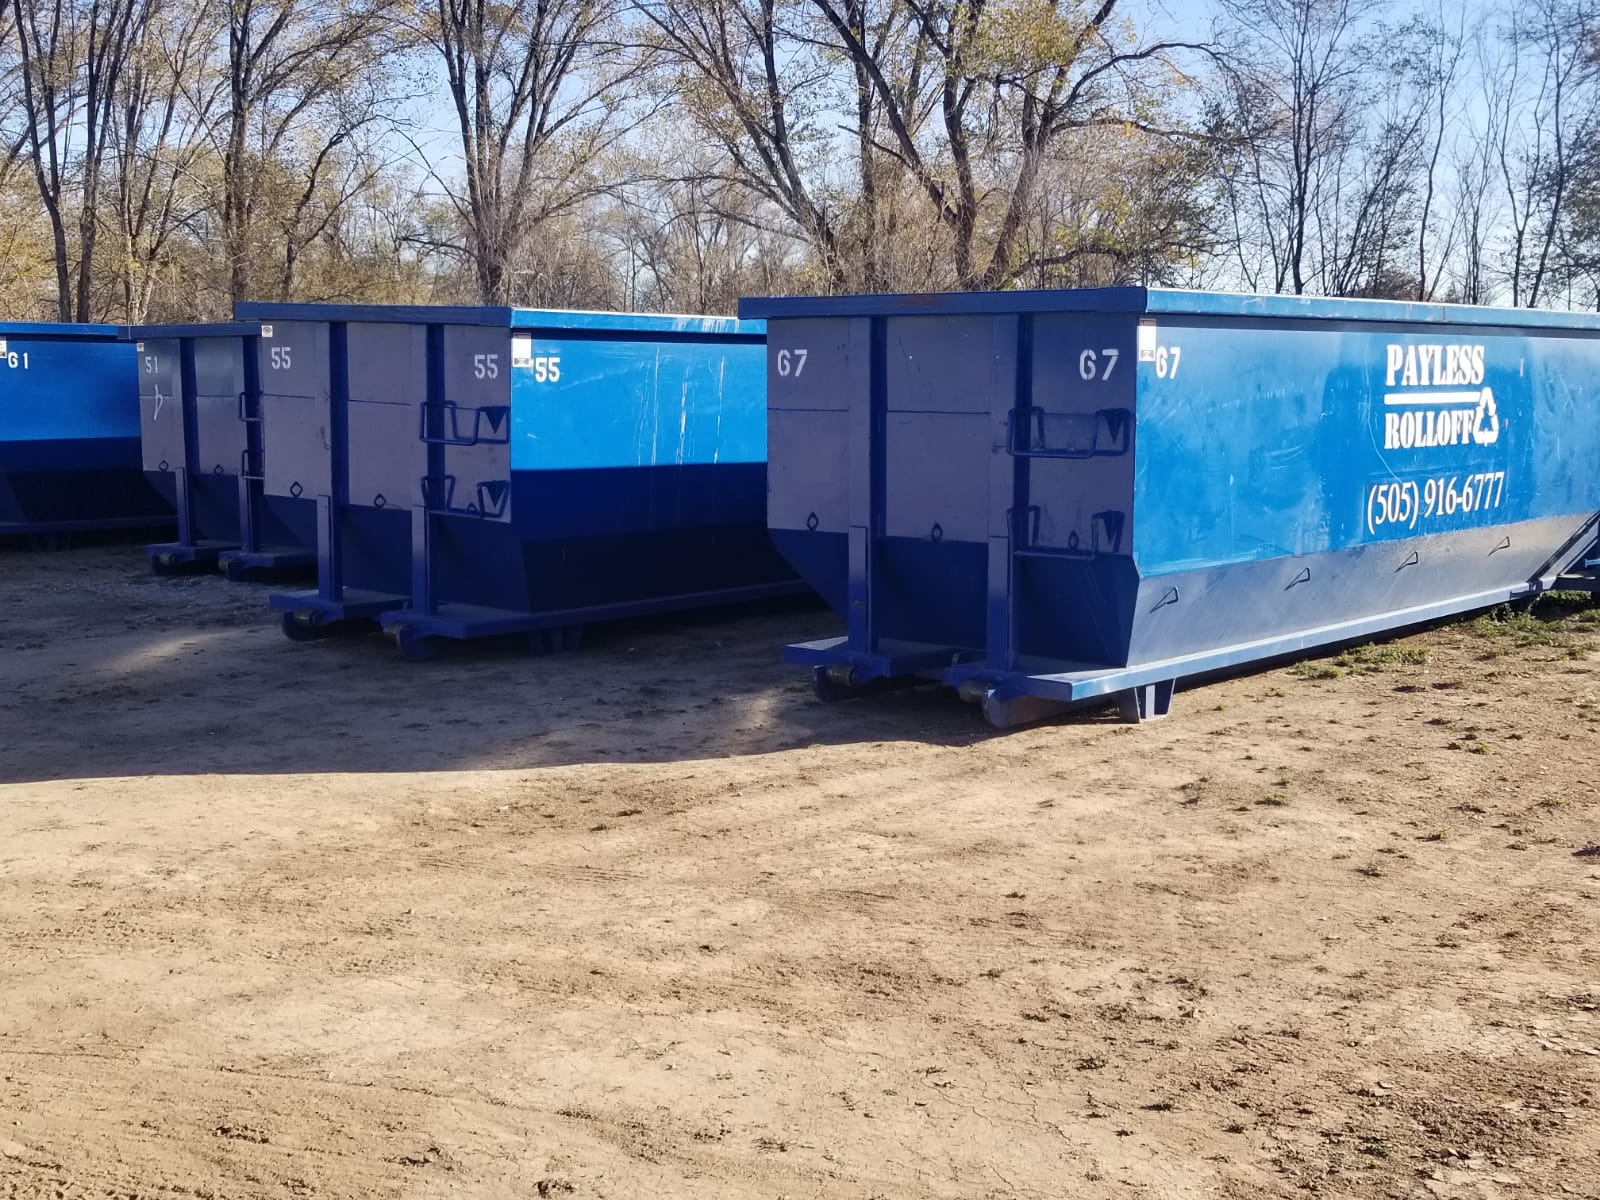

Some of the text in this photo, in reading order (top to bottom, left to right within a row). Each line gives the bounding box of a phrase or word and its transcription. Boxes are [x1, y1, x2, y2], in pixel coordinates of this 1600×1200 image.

[8, 352, 29, 369] 61
[145, 356, 159, 374] 51
[272, 346, 291, 369] 55
[474, 354, 498, 379] 55
[535, 356, 560, 382] 55
[777, 349, 808, 377] 67
[1080, 349, 1119, 380] 67
[1156, 346, 1181, 379] 67
[1386, 344, 1485, 386] PAYLESS
[1384, 409, 1475, 449] ROLLOFF
[1367, 471, 1505, 535] (505) 916-6777
